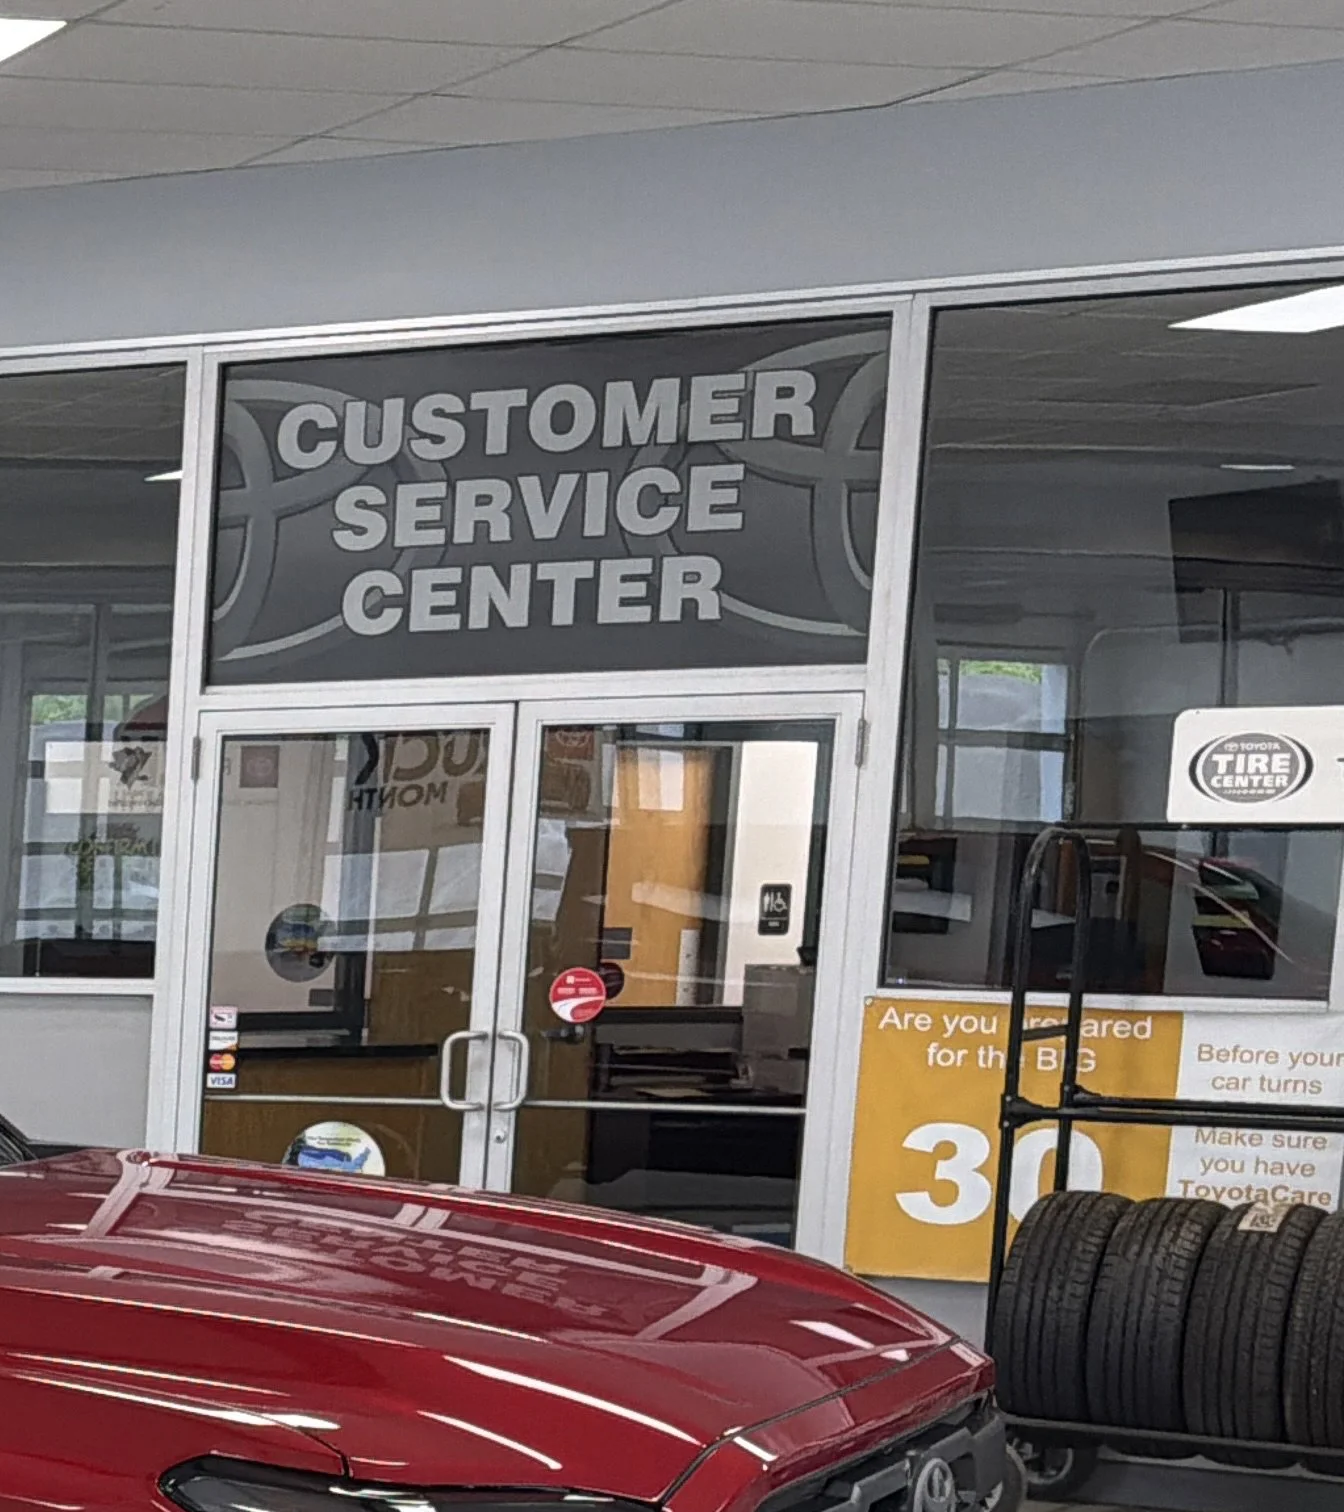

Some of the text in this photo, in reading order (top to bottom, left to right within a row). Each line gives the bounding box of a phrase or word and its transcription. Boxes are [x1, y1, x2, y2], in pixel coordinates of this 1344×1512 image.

[276, 370, 816, 469] CUSTOMER
[330, 463, 745, 552] SERVICE
[341, 554, 723, 636] CENTER
[1240, 742, 1280, 751] TOYOTA
[1212, 753, 1291, 774] TIRE
[1210, 775, 1289, 789] CENTER
[878, 1006, 1153, 1041] Are you reared
[927, 1042, 1097, 1073] for th BG
[1197, 1043, 1344, 1070] Before your
[210, 1076, 233, 1086] VISA
[1211, 1075, 1323, 1095] car turns
[1194, 1128, 1328, 1151] Make sure
[895, 1122, 1103, 1226] 30
[1200, 1155, 1316, 1178] you have
[1178, 1179, 1333, 1207] ToyotaCare
